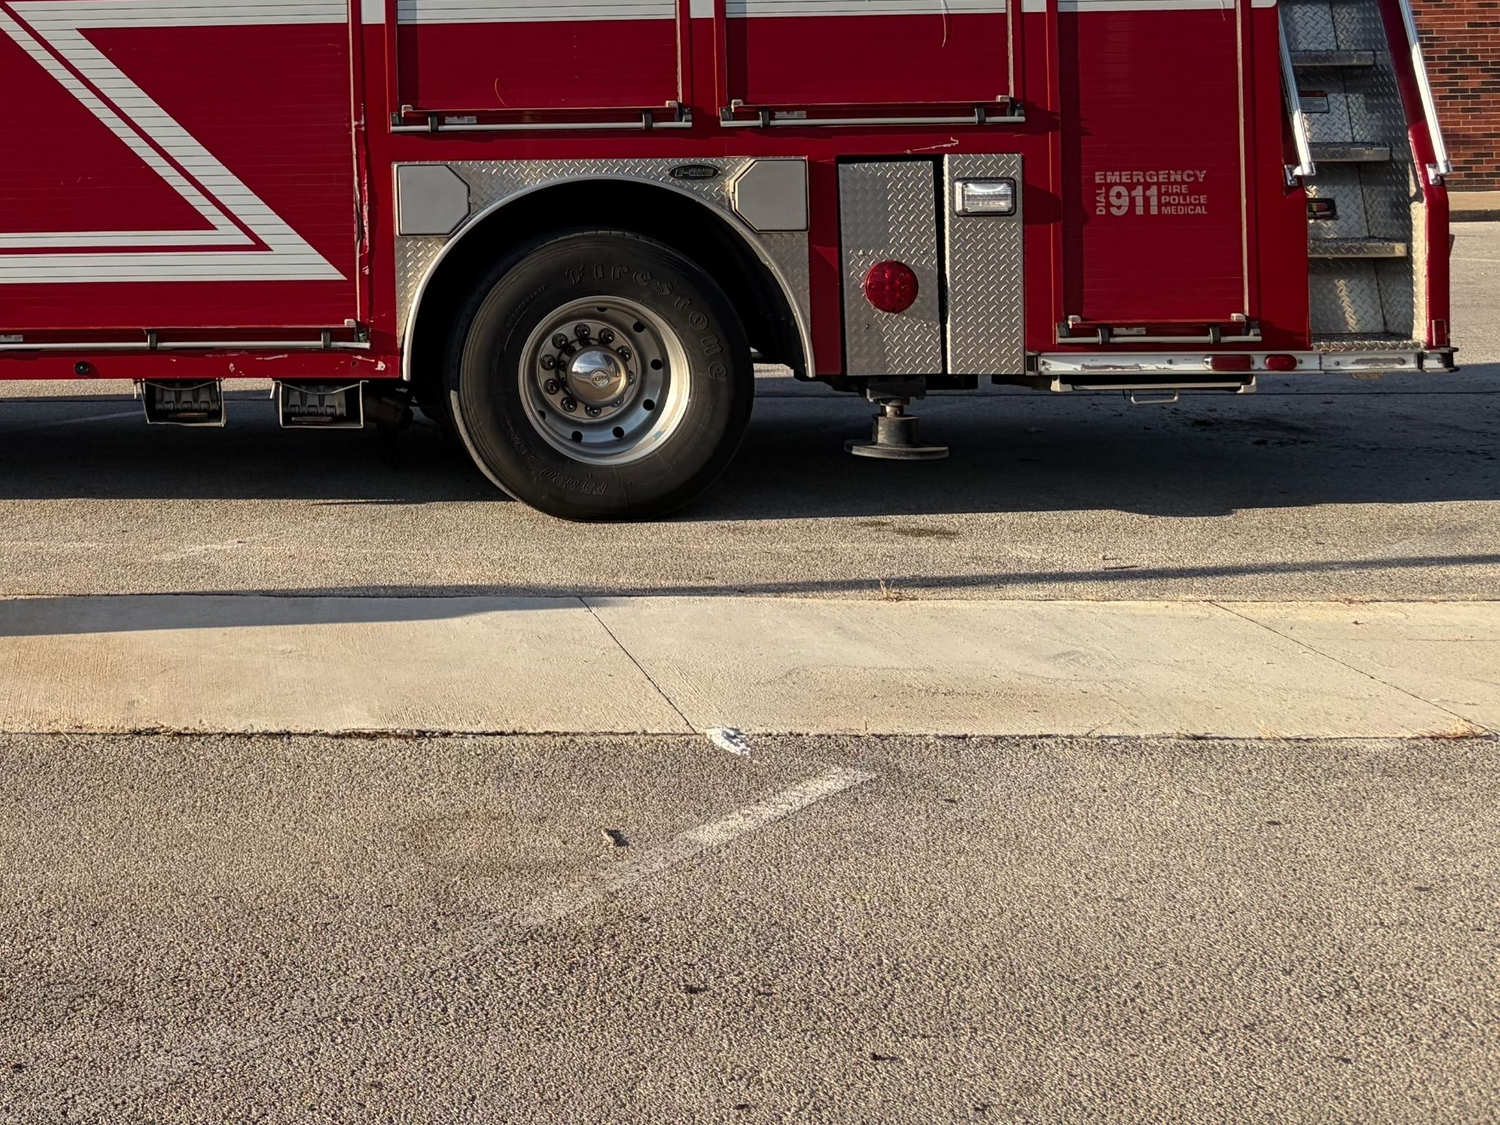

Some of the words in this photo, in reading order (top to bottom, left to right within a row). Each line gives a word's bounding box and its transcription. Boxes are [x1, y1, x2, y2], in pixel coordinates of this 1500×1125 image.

[1095, 170, 1207, 183] EMERGENCY
[1161, 185, 1189, 194] FIRE
[1096, 187, 1106, 215] DIAL
[1109, 185, 1159, 216] 911
[1161, 195, 1208, 204] POLICE
[1161, 206, 1208, 215] MEDICAL
[565, 259, 729, 381] Firestone
